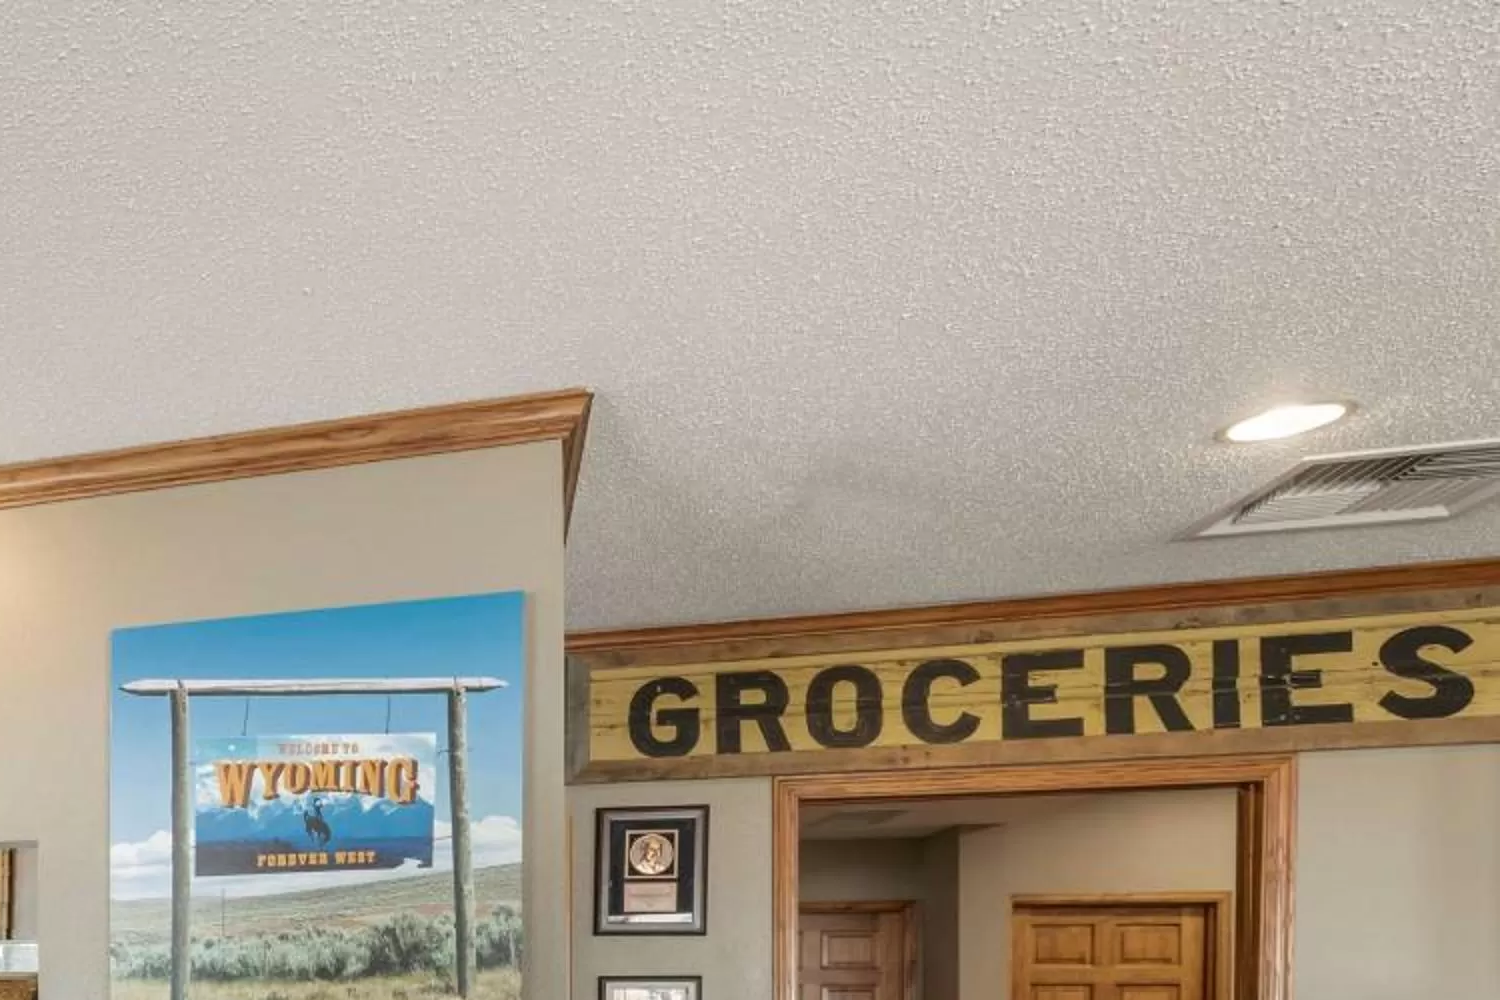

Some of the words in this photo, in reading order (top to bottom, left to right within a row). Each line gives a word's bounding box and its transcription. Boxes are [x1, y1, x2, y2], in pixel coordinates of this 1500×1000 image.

[627, 625, 1477, 759] GROCERIES
[213, 756, 420, 809] WYOMING
[257, 852, 329, 868] FOREVER
[335, 850, 377, 866] WEST
